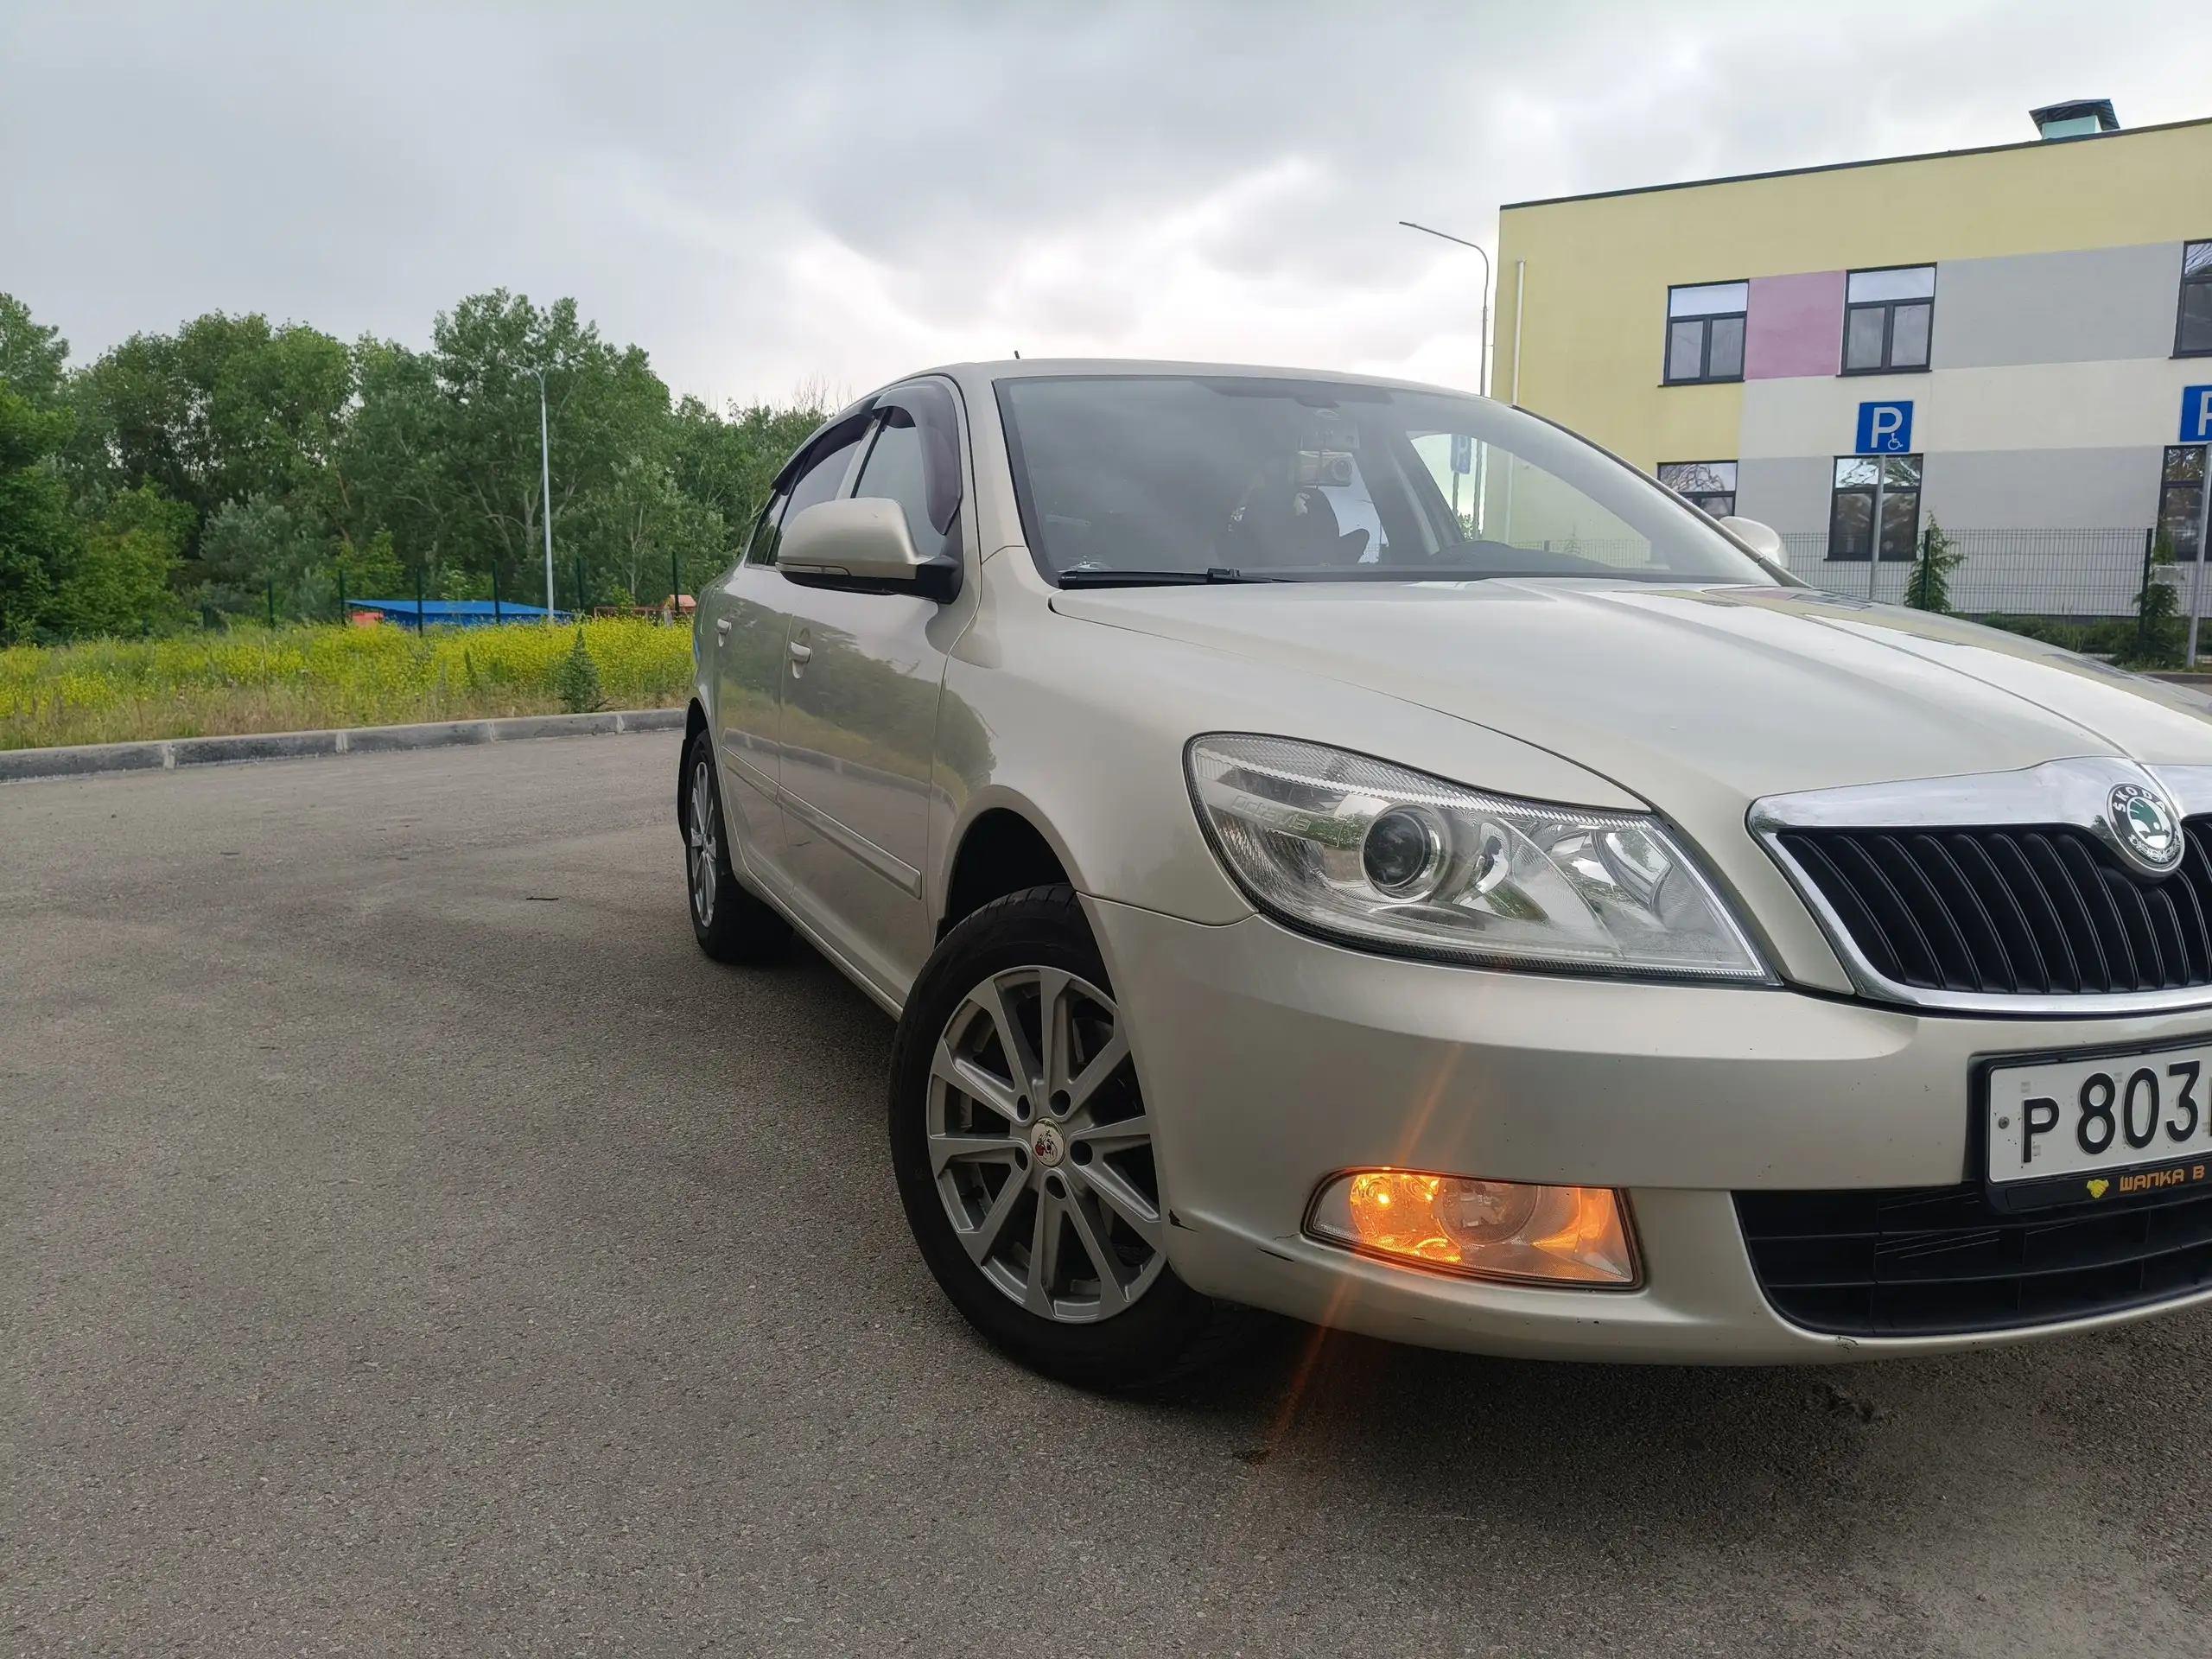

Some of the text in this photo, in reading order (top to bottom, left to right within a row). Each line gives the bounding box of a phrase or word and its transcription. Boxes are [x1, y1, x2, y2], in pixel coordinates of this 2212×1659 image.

[1871, 407, 1903, 448] P
[2022, 1059, 2212, 1163] Р803
[2120, 1165, 2205, 1192] ШАПКА В
